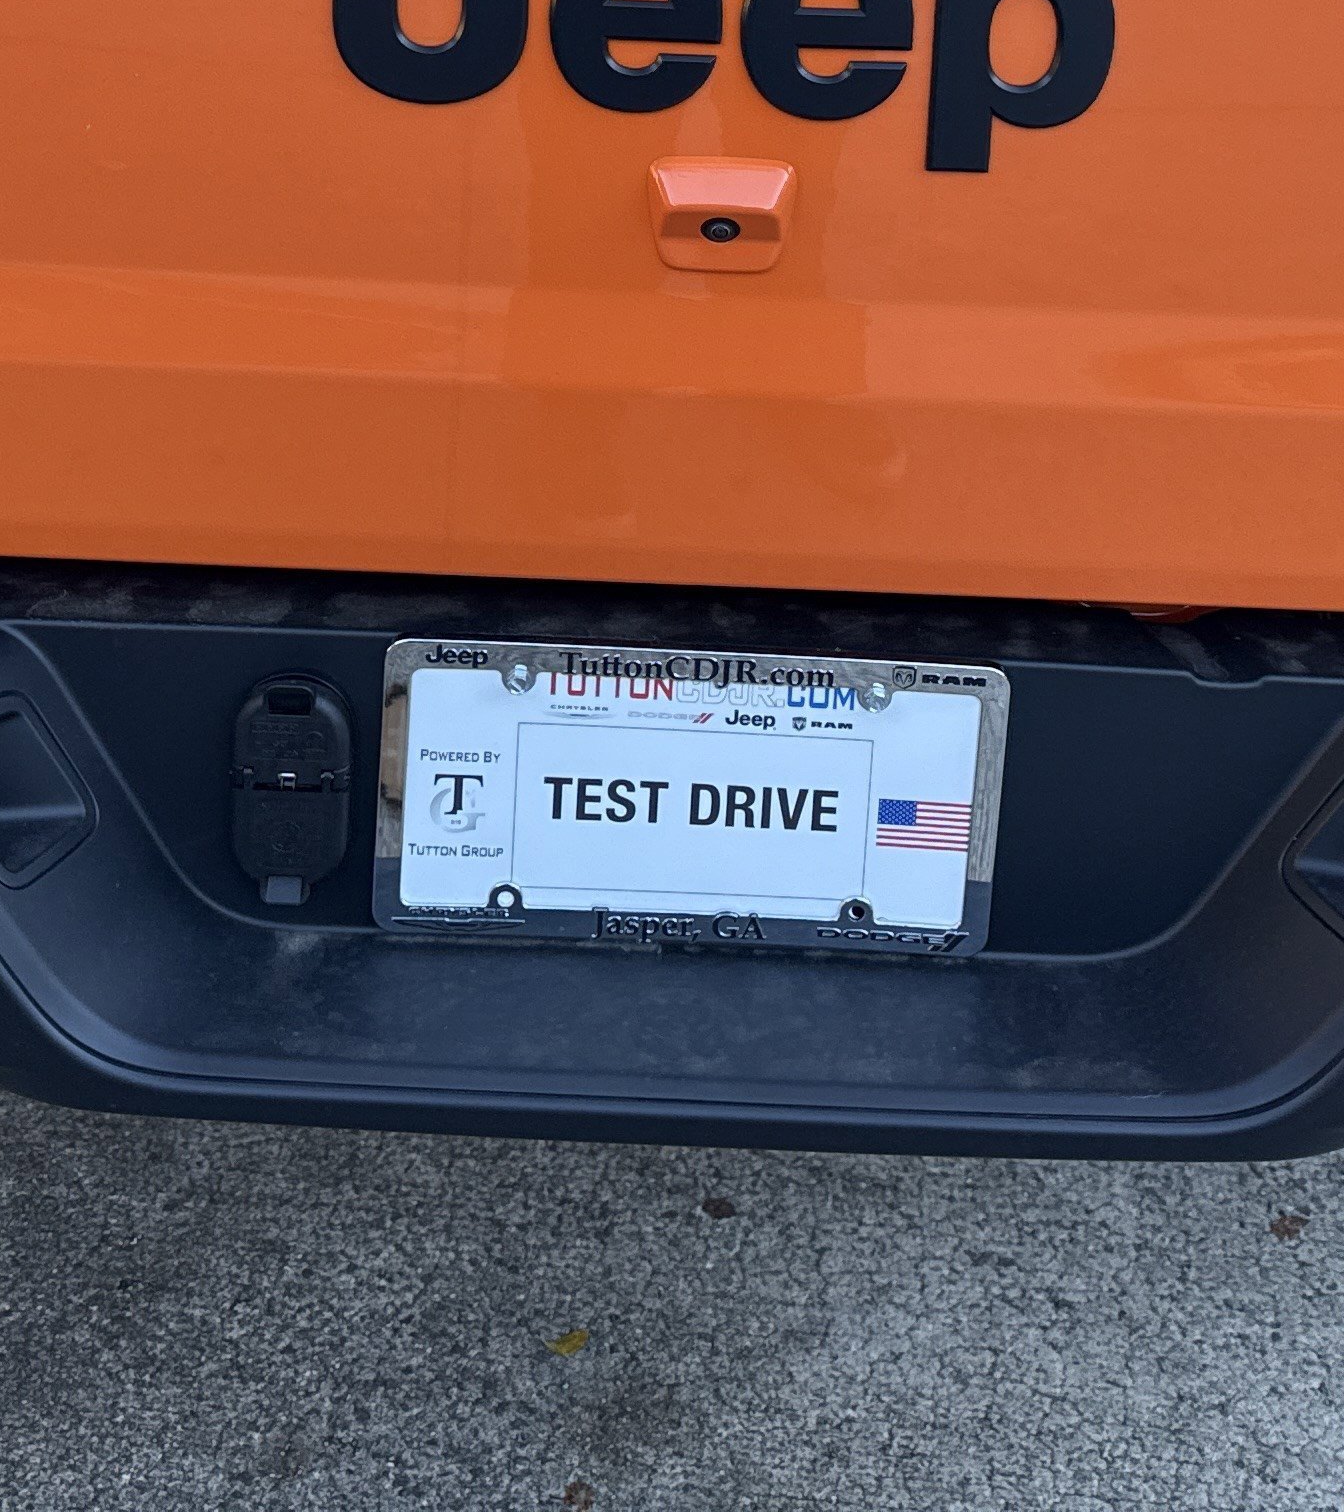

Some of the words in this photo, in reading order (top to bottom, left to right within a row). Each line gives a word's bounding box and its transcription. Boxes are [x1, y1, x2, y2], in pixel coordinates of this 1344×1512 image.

[425, 644, 489, 669] Jeep
[559, 651, 836, 688] TuttonCDJR.com
[921, 674, 987, 688] RAM
[725, 709, 776, 730] Jeep
[810, 721, 853, 730] RAM
[543, 776, 669, 824] TEST
[689, 782, 839, 833] DRIVE
[590, 906, 702, 943] Jasper,
[711, 910, 766, 940] GA
[816, 926, 948, 945] DODGE
